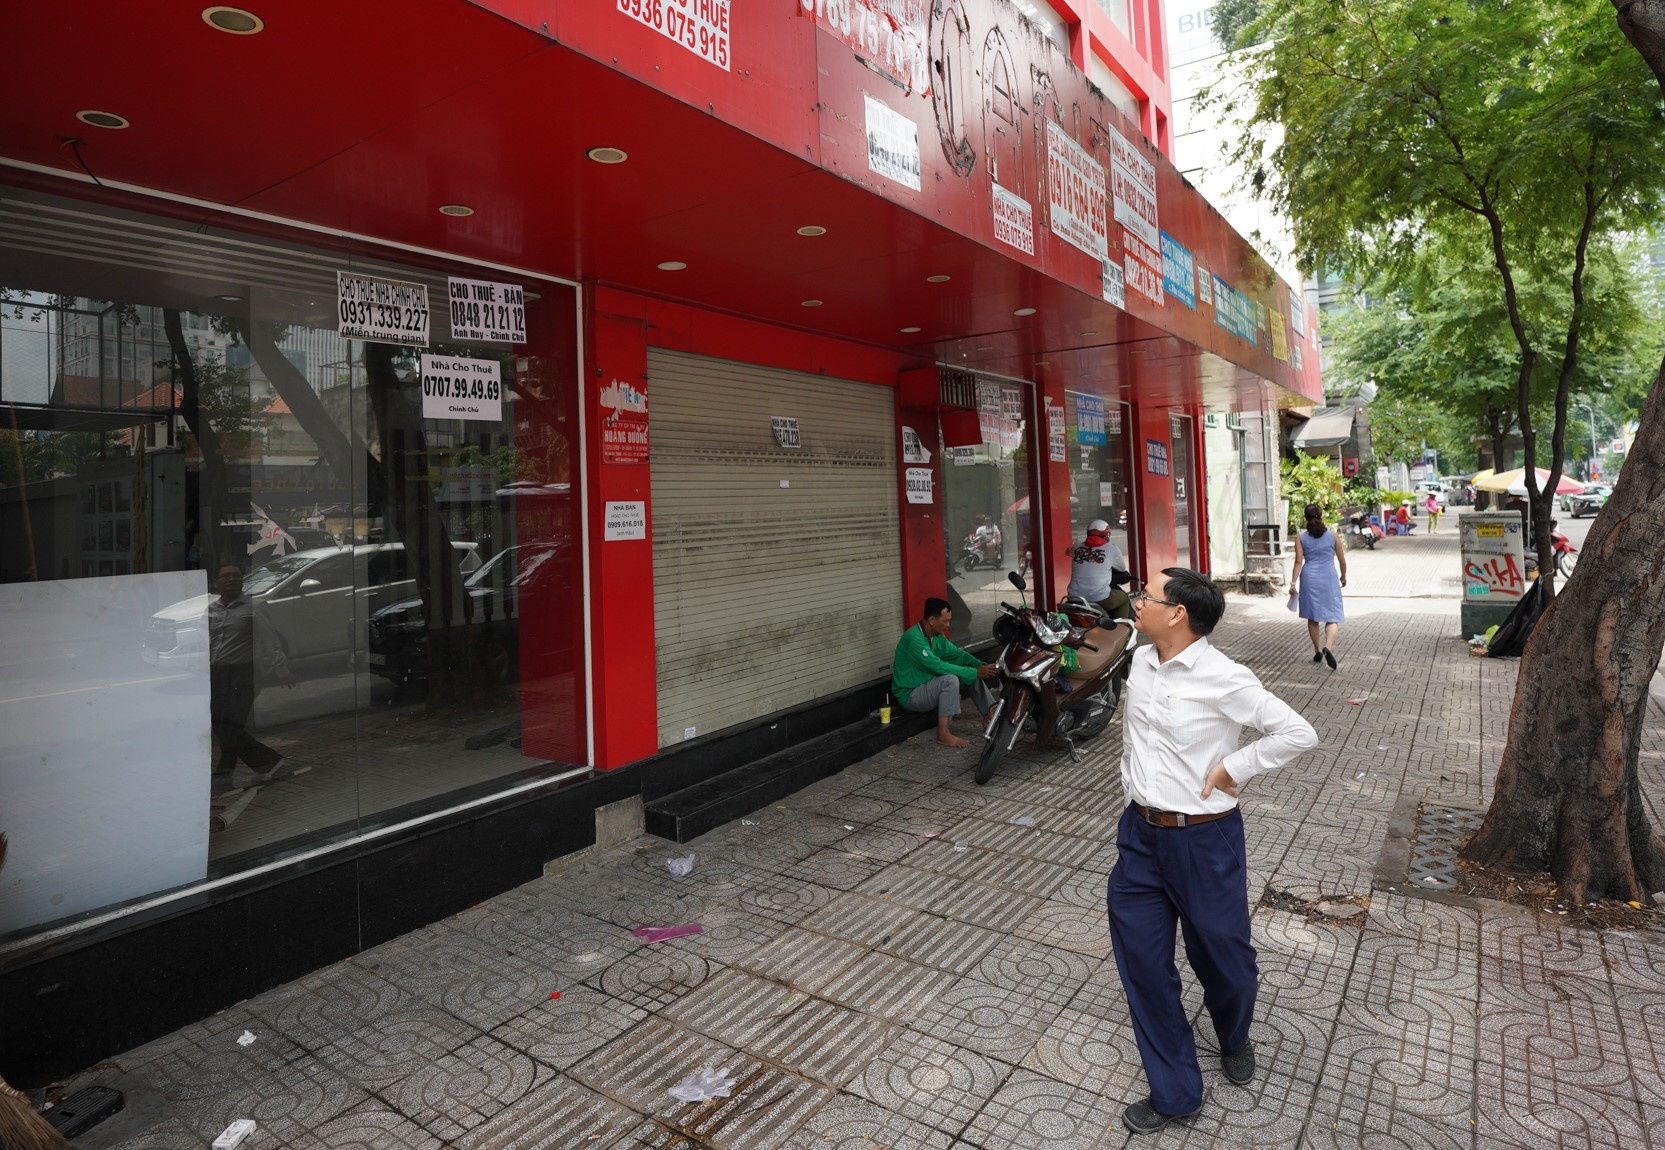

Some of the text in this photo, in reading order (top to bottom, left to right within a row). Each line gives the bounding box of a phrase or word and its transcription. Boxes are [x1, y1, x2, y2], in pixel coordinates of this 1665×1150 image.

[666, 5, 697, 48] 075
[700, 25, 727, 67] 915
[1127, 151, 1140, 178] CHO
[1006, 203, 1018, 225] CHO
[340, 277, 355, 299] CHO
[356, 277, 374, 302] THUÊ
[376, 280, 390, 304] NHÀ
[391, 282, 411, 307] CHÍNH
[450, 282, 469, 300] CHO
[471, 283, 495, 302] THUÊ
[504, 286, 523, 306] BÁN
[340, 298, 428, 332] 0931.339.227
[451, 300, 525, 332] 0848 21 21 12
[372, 330, 399, 343] trung
[401, 333, 425, 345] gian)
[454, 328, 468, 338] Anh
[470, 330, 484, 340] Huy
[431, 360, 493, 374] Nhà Cho Thuê
[423, 375, 500, 401] 0707.99.49.69
[604, 427, 626, 443] HOÀNG
